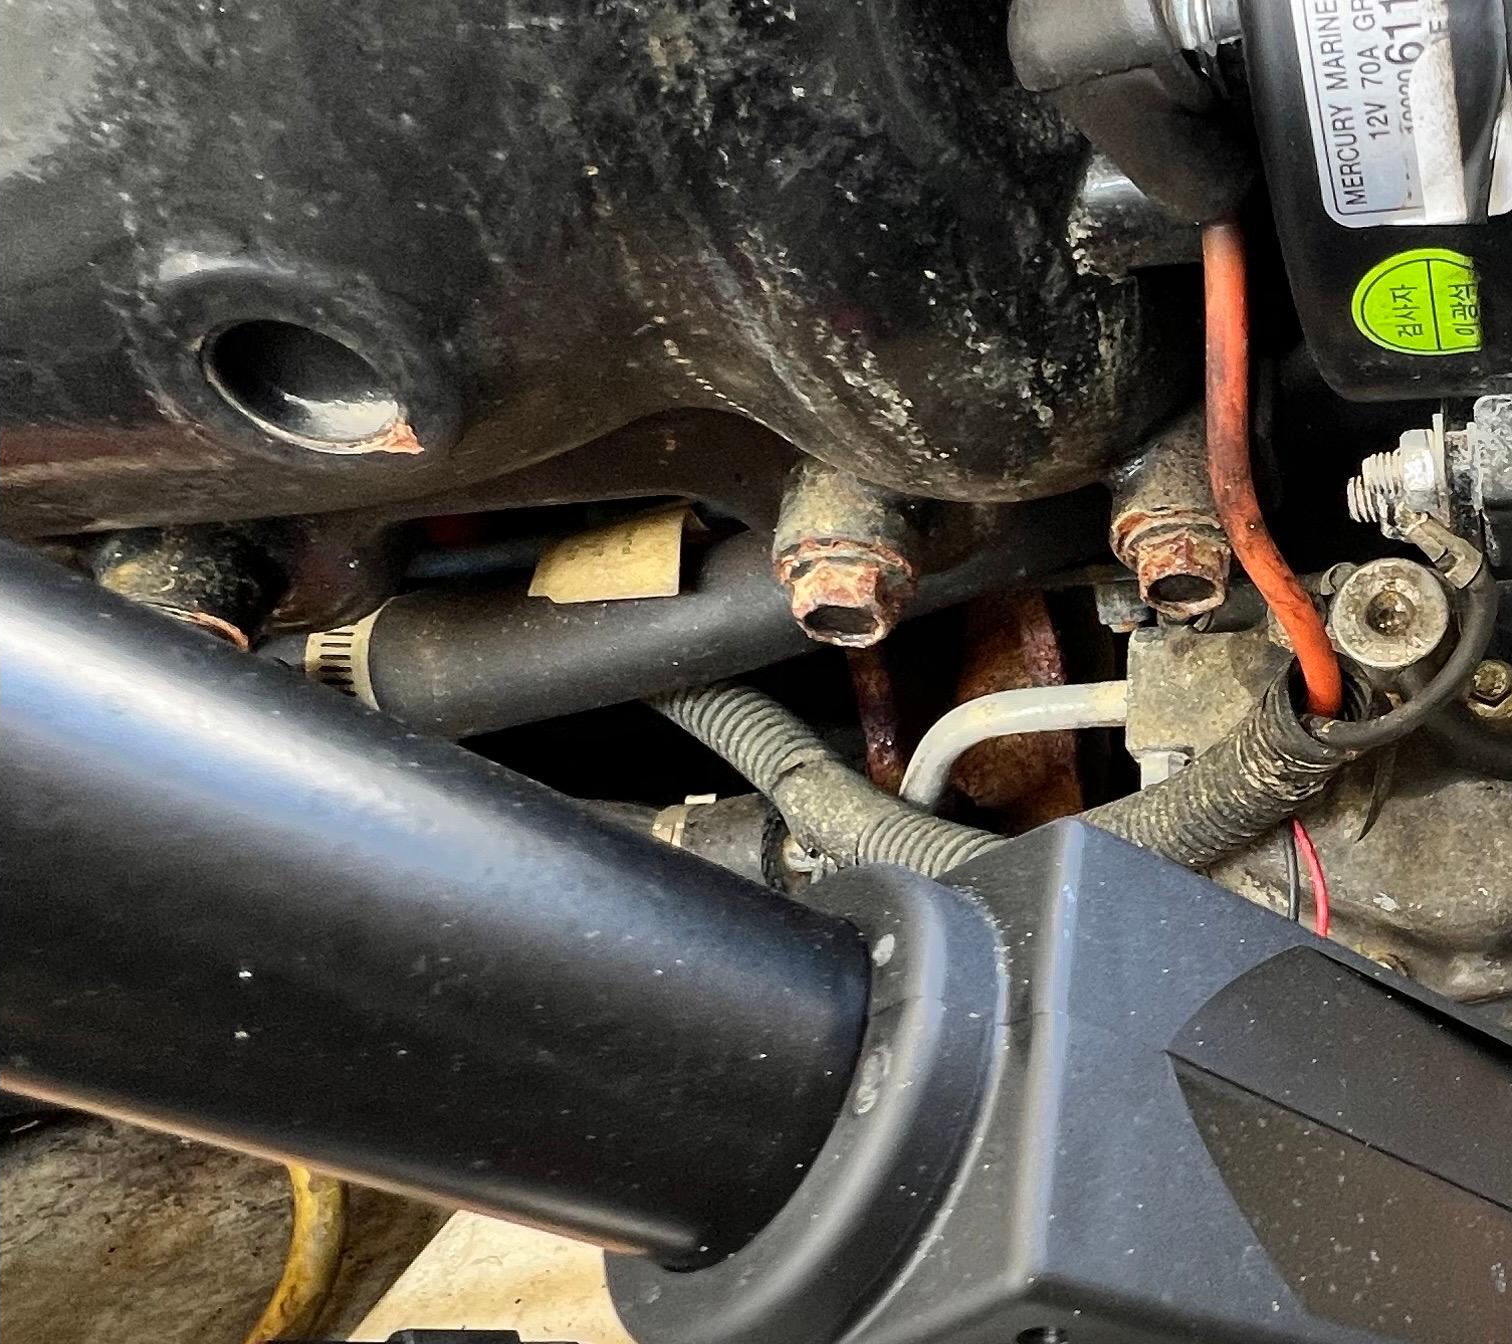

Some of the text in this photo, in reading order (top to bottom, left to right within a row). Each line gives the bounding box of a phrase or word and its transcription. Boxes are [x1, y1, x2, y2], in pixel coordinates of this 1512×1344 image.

[1314, 0, 1349, 90] MARINE
[1357, 44, 1384, 88] 70A
[1364, 100, 1391, 140] 12V
[1326, 103, 1368, 204] MERCURY
[1387, 282, 1424, 338] 검사자
